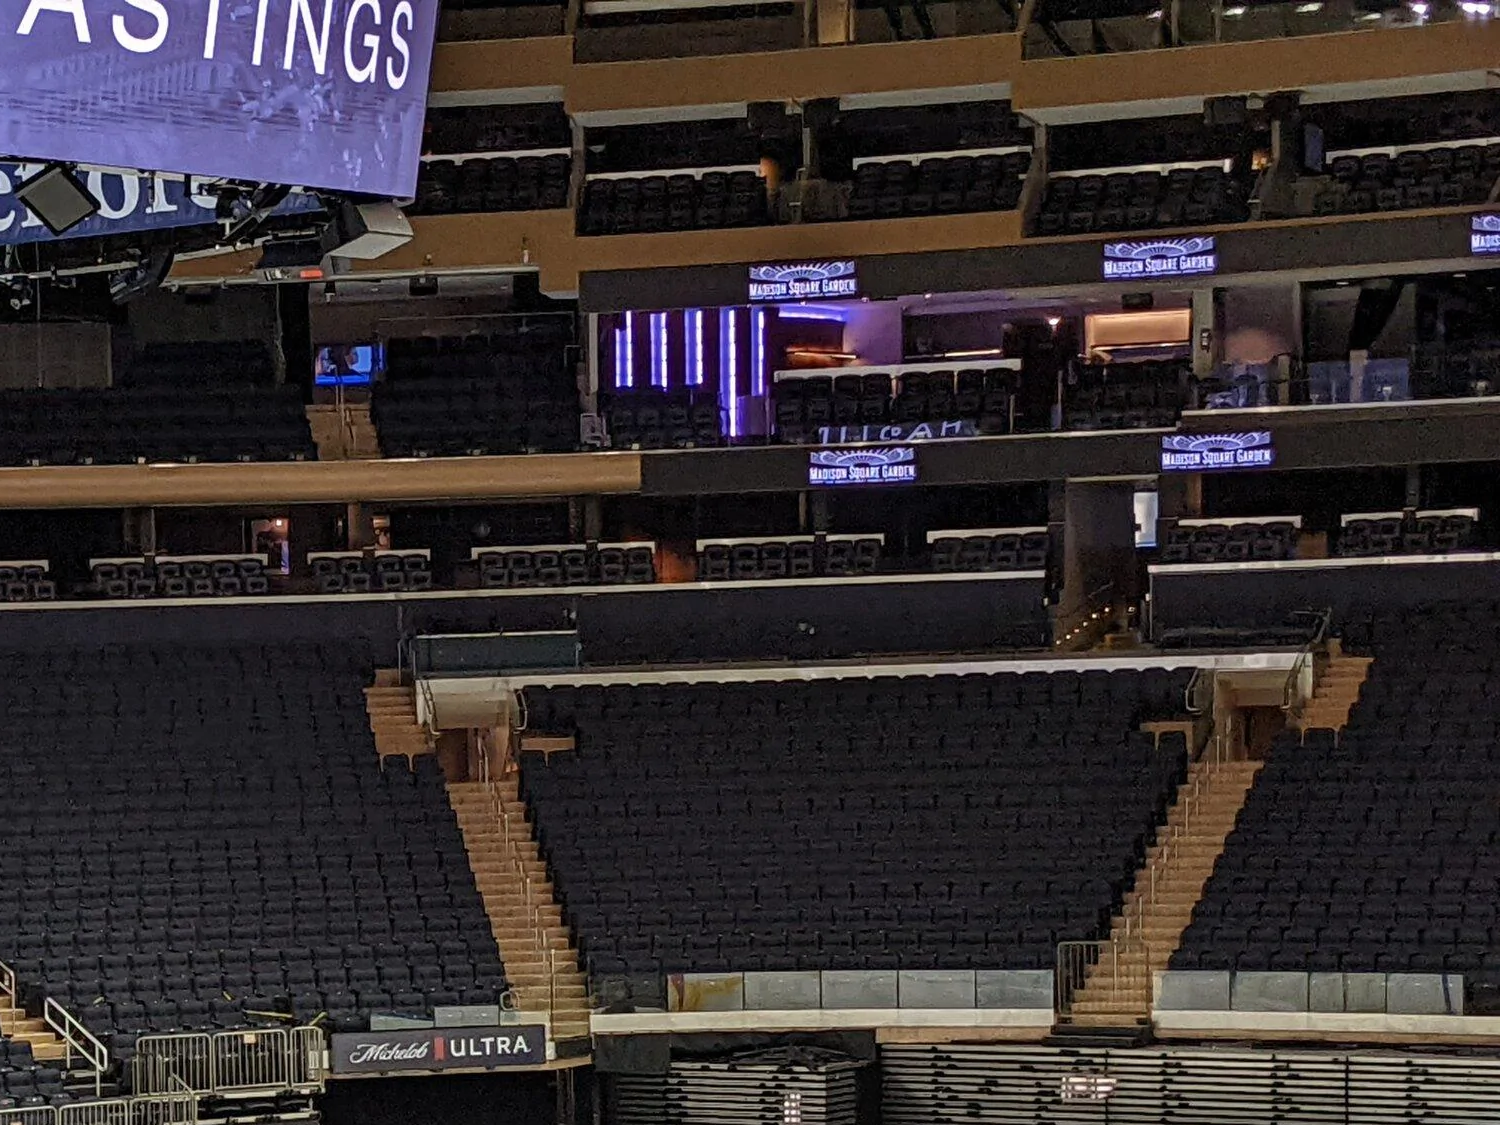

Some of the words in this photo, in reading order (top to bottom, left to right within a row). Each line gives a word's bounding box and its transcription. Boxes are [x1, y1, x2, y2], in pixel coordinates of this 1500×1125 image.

[809, 467, 847, 479] MADISON
[848, 465, 880, 479] SQUARE
[882, 464, 915, 478] GARDEN
[350, 1041, 430, 1064] Michelob
[450, 1035, 530, 1057] ULTRA
